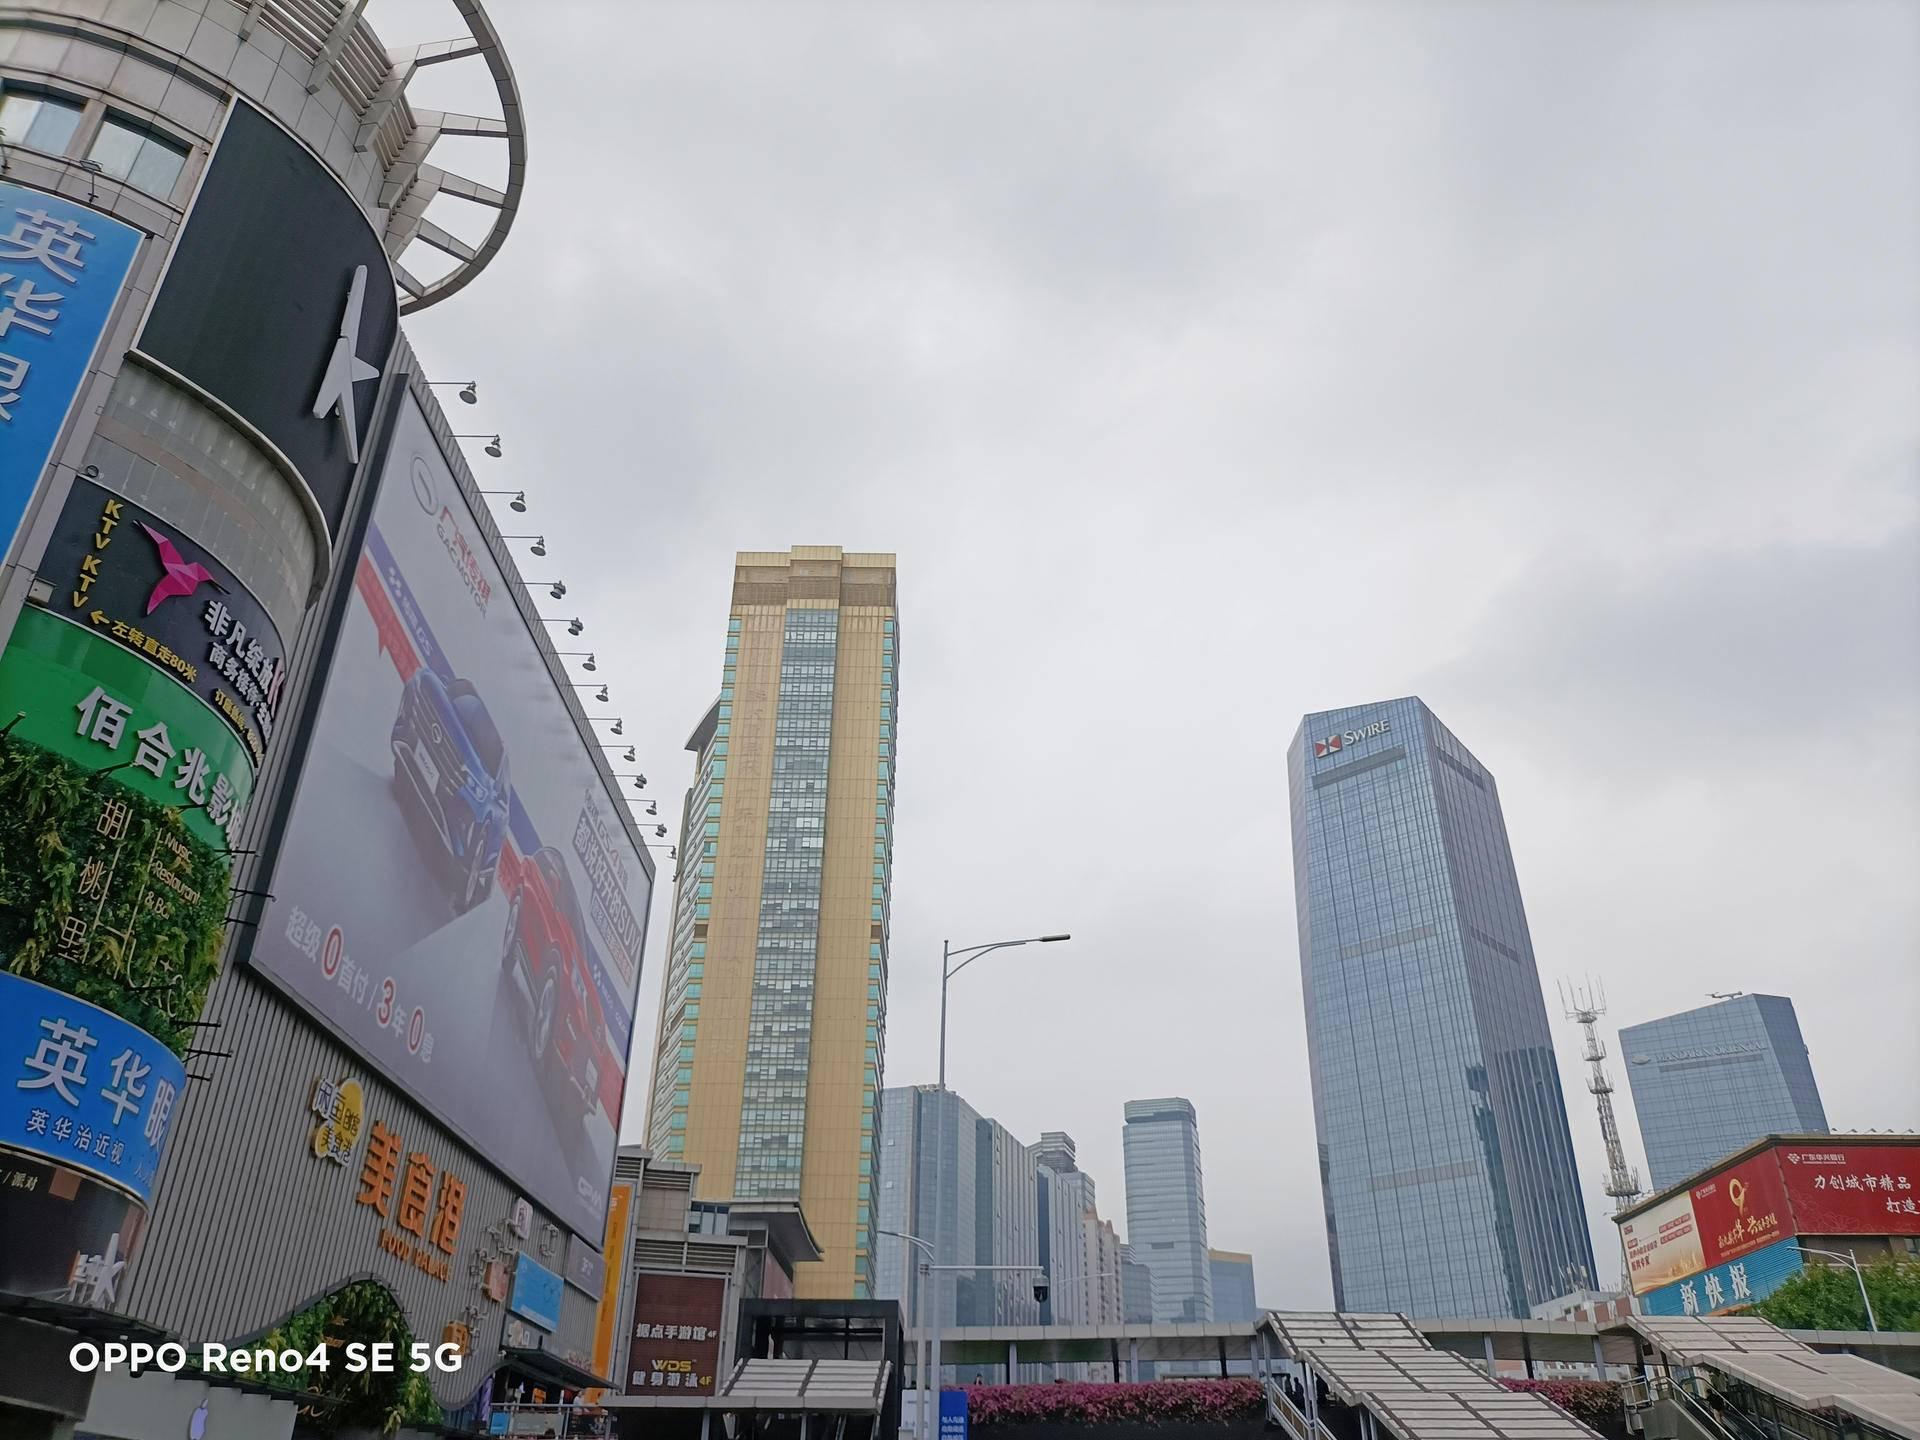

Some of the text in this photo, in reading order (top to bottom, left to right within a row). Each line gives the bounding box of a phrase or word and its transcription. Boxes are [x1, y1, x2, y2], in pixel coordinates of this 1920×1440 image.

[73, 499, 124, 608] KTV KTV
[111, 619, 198, 684] 左转直走80米
[1343, 719, 1391, 746] SWIRE
[164, 832, 193, 864] Music
[58, 798, 127, 963] 胡桃里
[153, 859, 201, 906] Restaurant
[574, 815, 642, 956] 都说好开的SUV
[26, 1109, 125, 1165] 英华治近视
[1814, 1173, 1912, 1193] 力创城市精品
[1886, 1197, 1920, 1215] 打造
[379, 1229, 454, 1283] FOOD PALACE
[1680, 1262, 1752, 1316] 新快报
[707, 1330, 718, 1339] 4F
[632, 1371, 713, 1388] 健身游泳 4F
[651, 1360, 692, 1372] WDS
